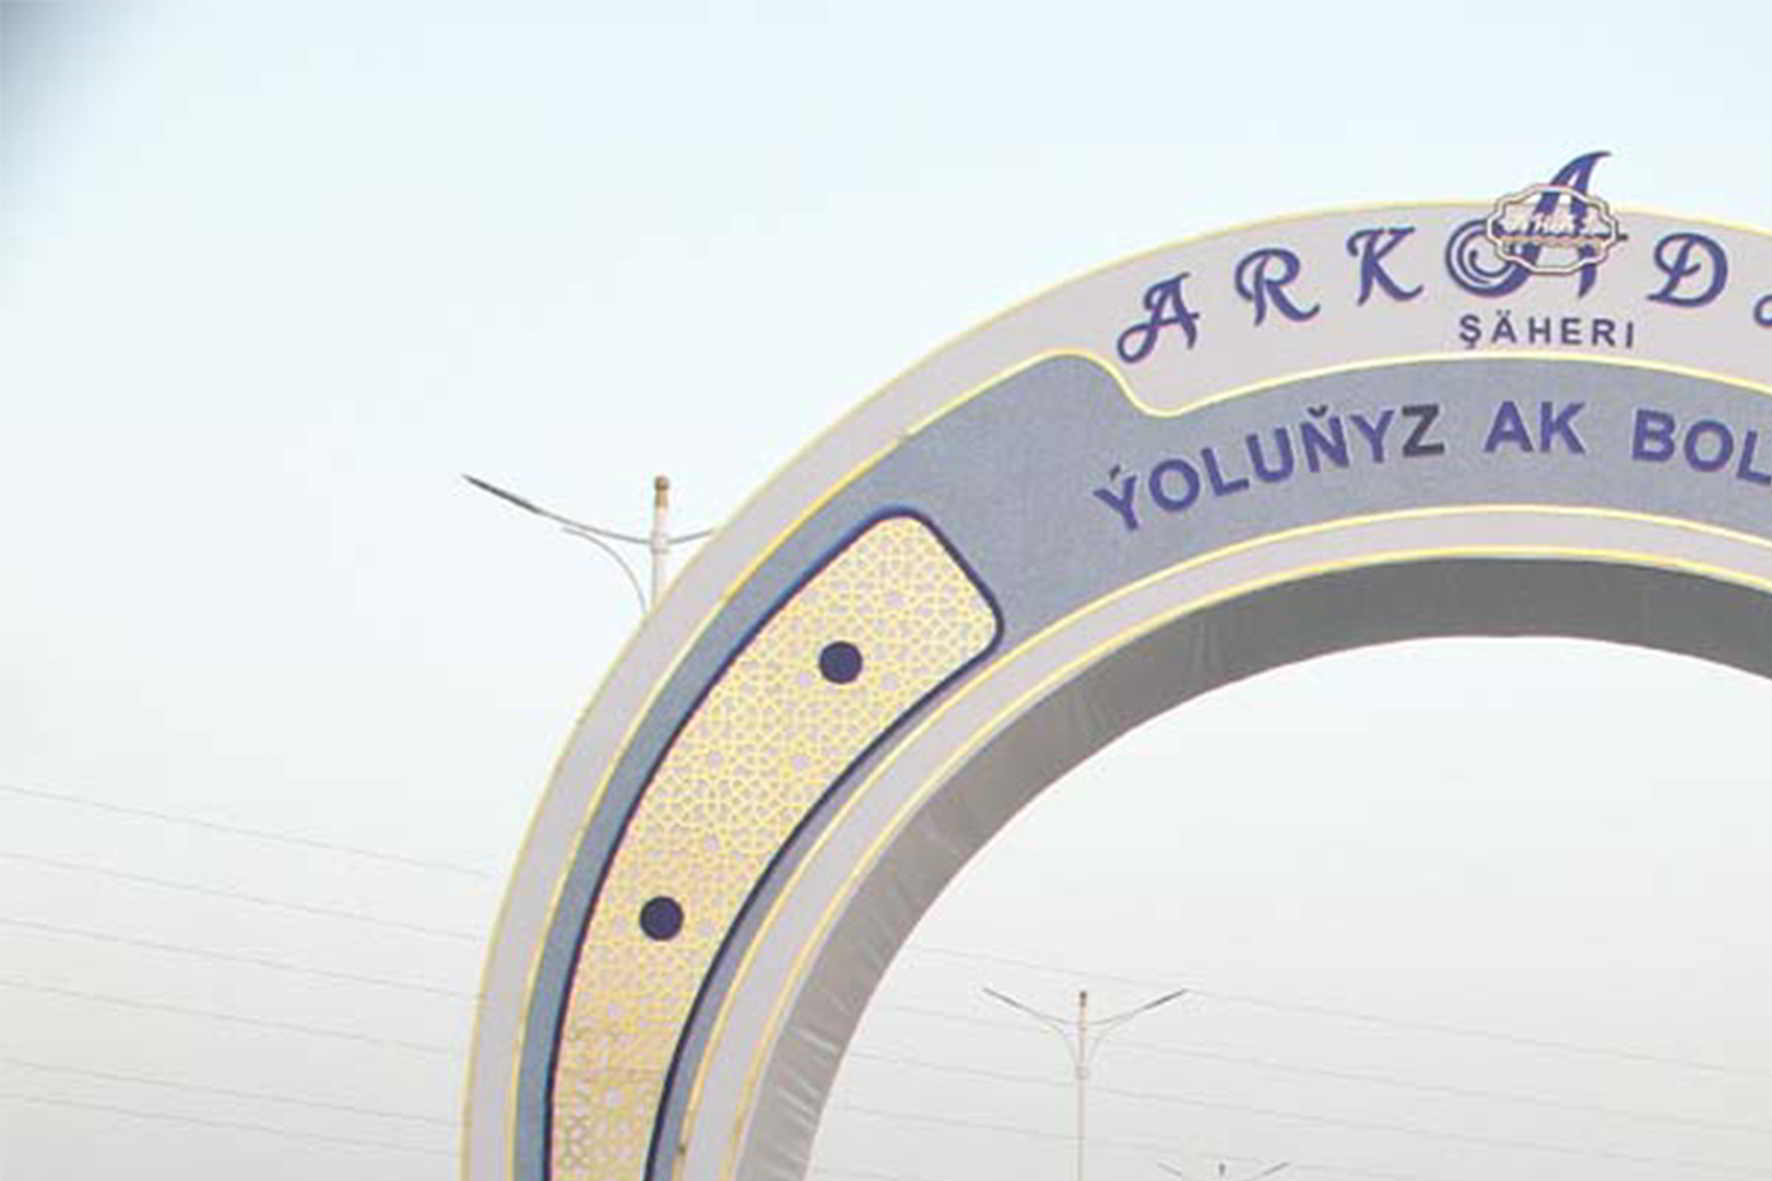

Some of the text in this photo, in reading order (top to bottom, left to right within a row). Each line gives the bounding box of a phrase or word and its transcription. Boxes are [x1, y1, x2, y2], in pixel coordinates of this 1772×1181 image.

[1459, 309, 1635, 349] ŞÄHERI
[1093, 403, 1446, 531] ÝOLUŇYZ
[1484, 401, 1586, 453] AK
